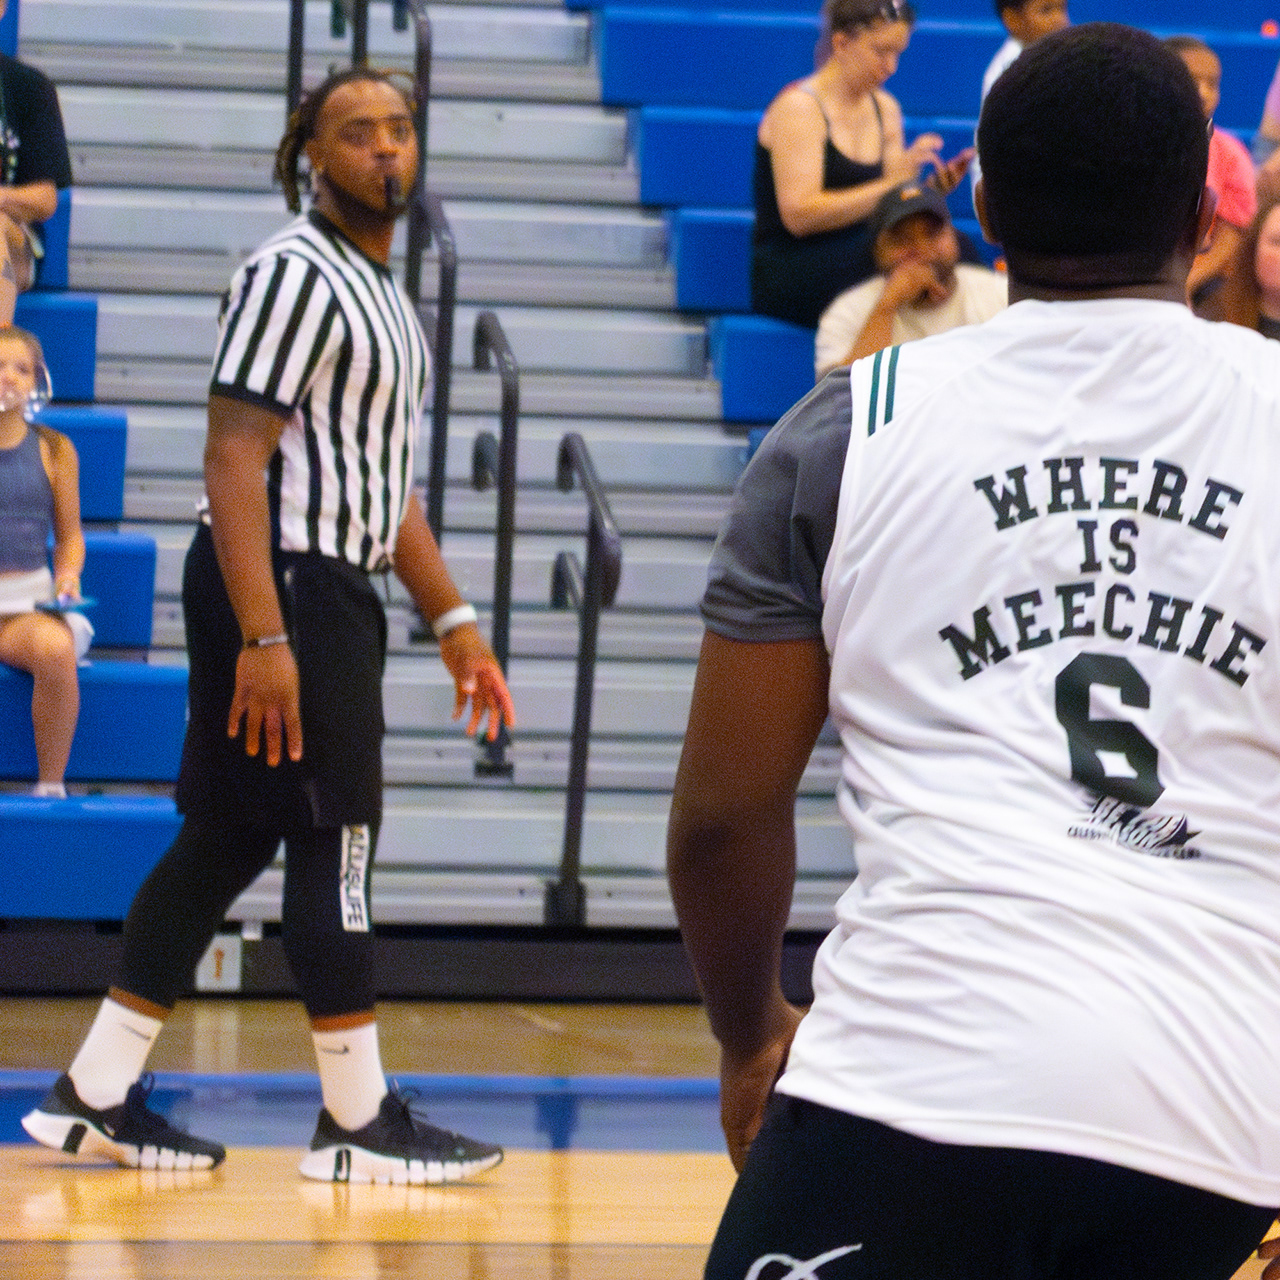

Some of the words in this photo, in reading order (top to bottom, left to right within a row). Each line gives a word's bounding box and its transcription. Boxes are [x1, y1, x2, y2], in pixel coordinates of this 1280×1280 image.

[973, 457, 1243, 540] WHERE
[1076, 519, 1139, 575] IS
[938, 583, 1268, 689] MEECHIE
[1055, 651, 1164, 806] 6
